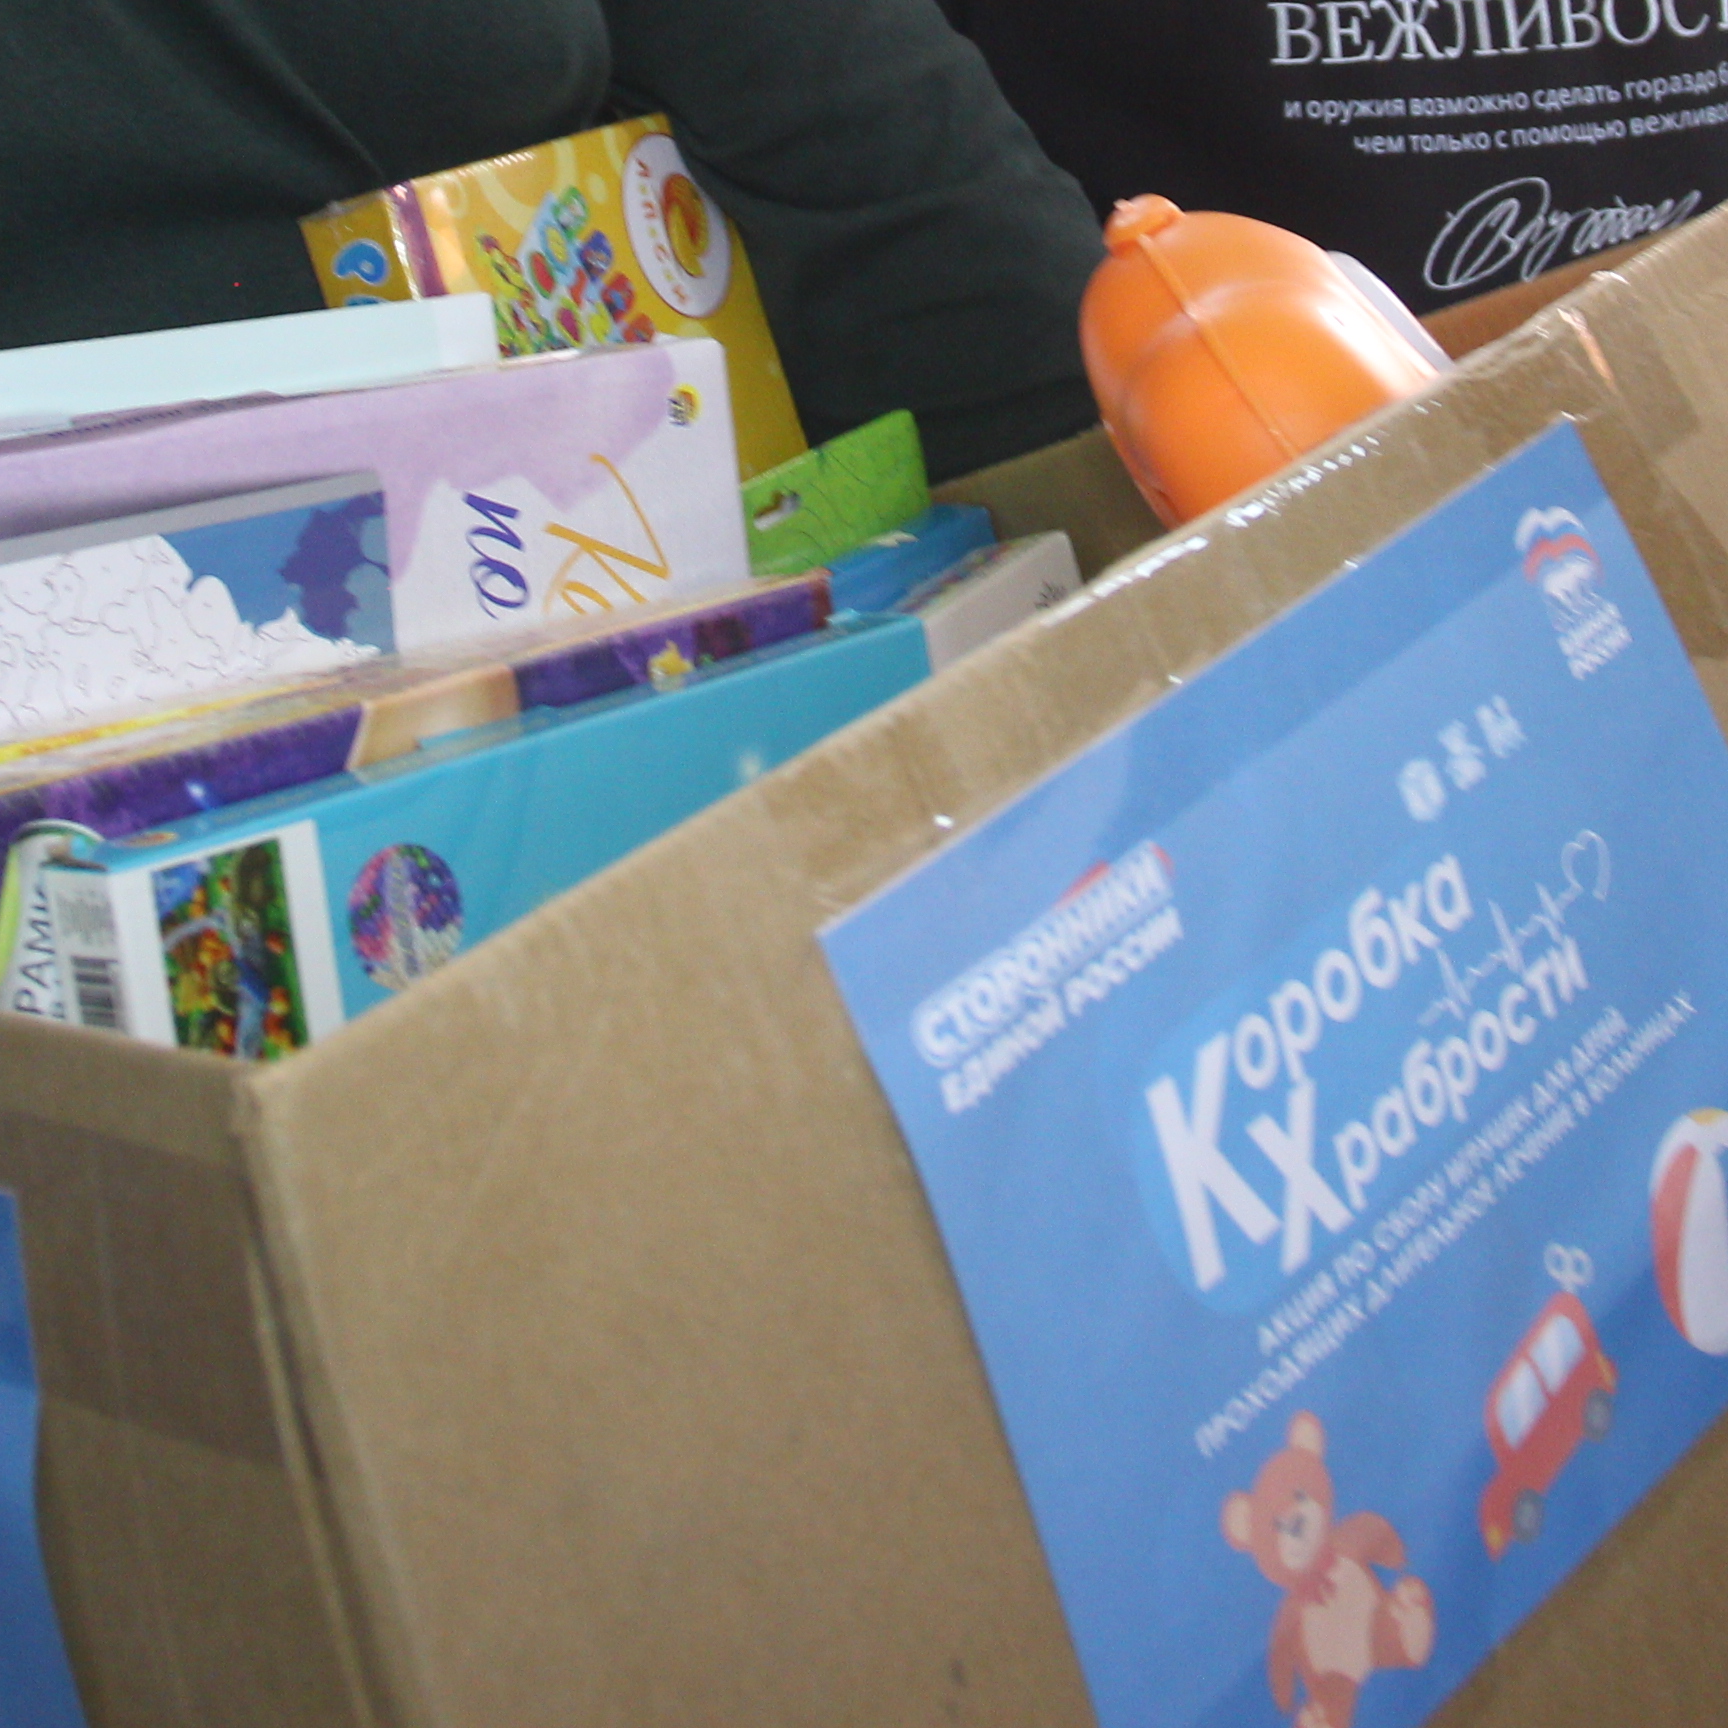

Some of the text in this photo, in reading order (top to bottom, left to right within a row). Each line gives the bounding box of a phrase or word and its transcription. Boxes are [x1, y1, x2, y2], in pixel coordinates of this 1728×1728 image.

[1284, 100, 1303, 119] и
[1305, 98, 1407, 125] оружия
[1408, 89, 1531, 118] возможно
[1532, 83, 1622, 113] сделать
[1624, 68, 1718, 104] гораздо
[1353, 134, 1407, 156] чем
[1409, 129, 1492, 155] только
[1494, 129, 1510, 150] с
[1511, 118, 1627, 149] помощью
[915, 842, 1170, 1068] СТОРОННИКИ
[1145, 852, 1472, 1292] Коробка
[1246, 935, 1589, 1276] Храбрости
